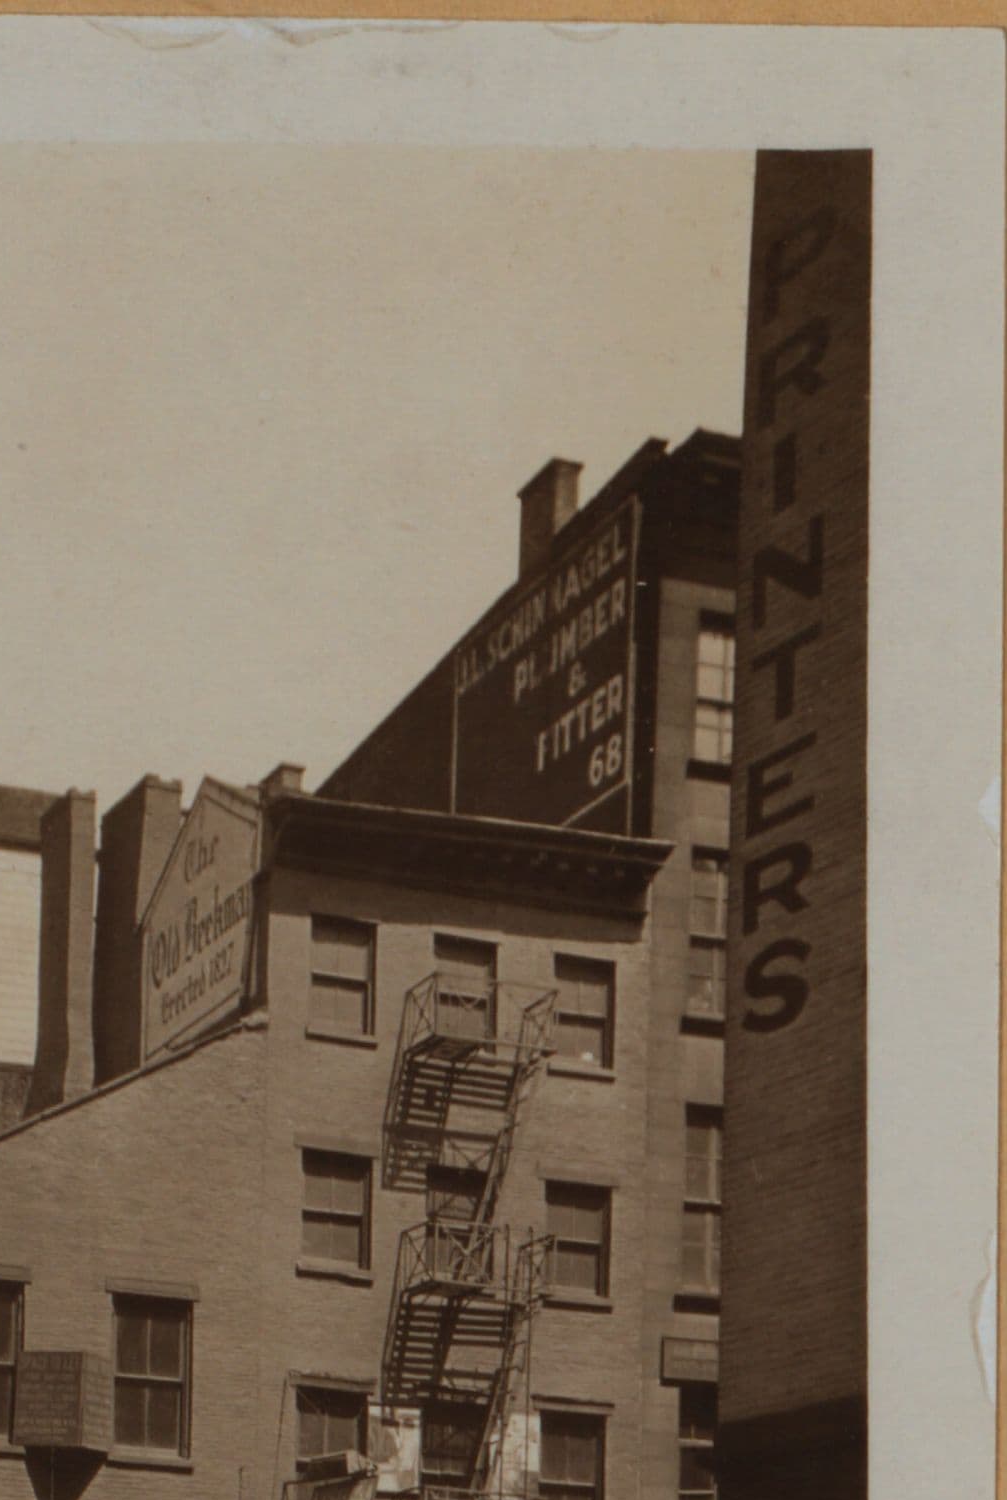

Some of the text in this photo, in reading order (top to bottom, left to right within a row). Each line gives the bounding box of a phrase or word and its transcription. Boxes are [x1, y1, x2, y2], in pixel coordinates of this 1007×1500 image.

[740, 205, 839, 1033] PRINTERS
[568, 660, 586, 698] &
[537, 673, 622, 773] FITTER
[588, 732, 622, 787] 68
